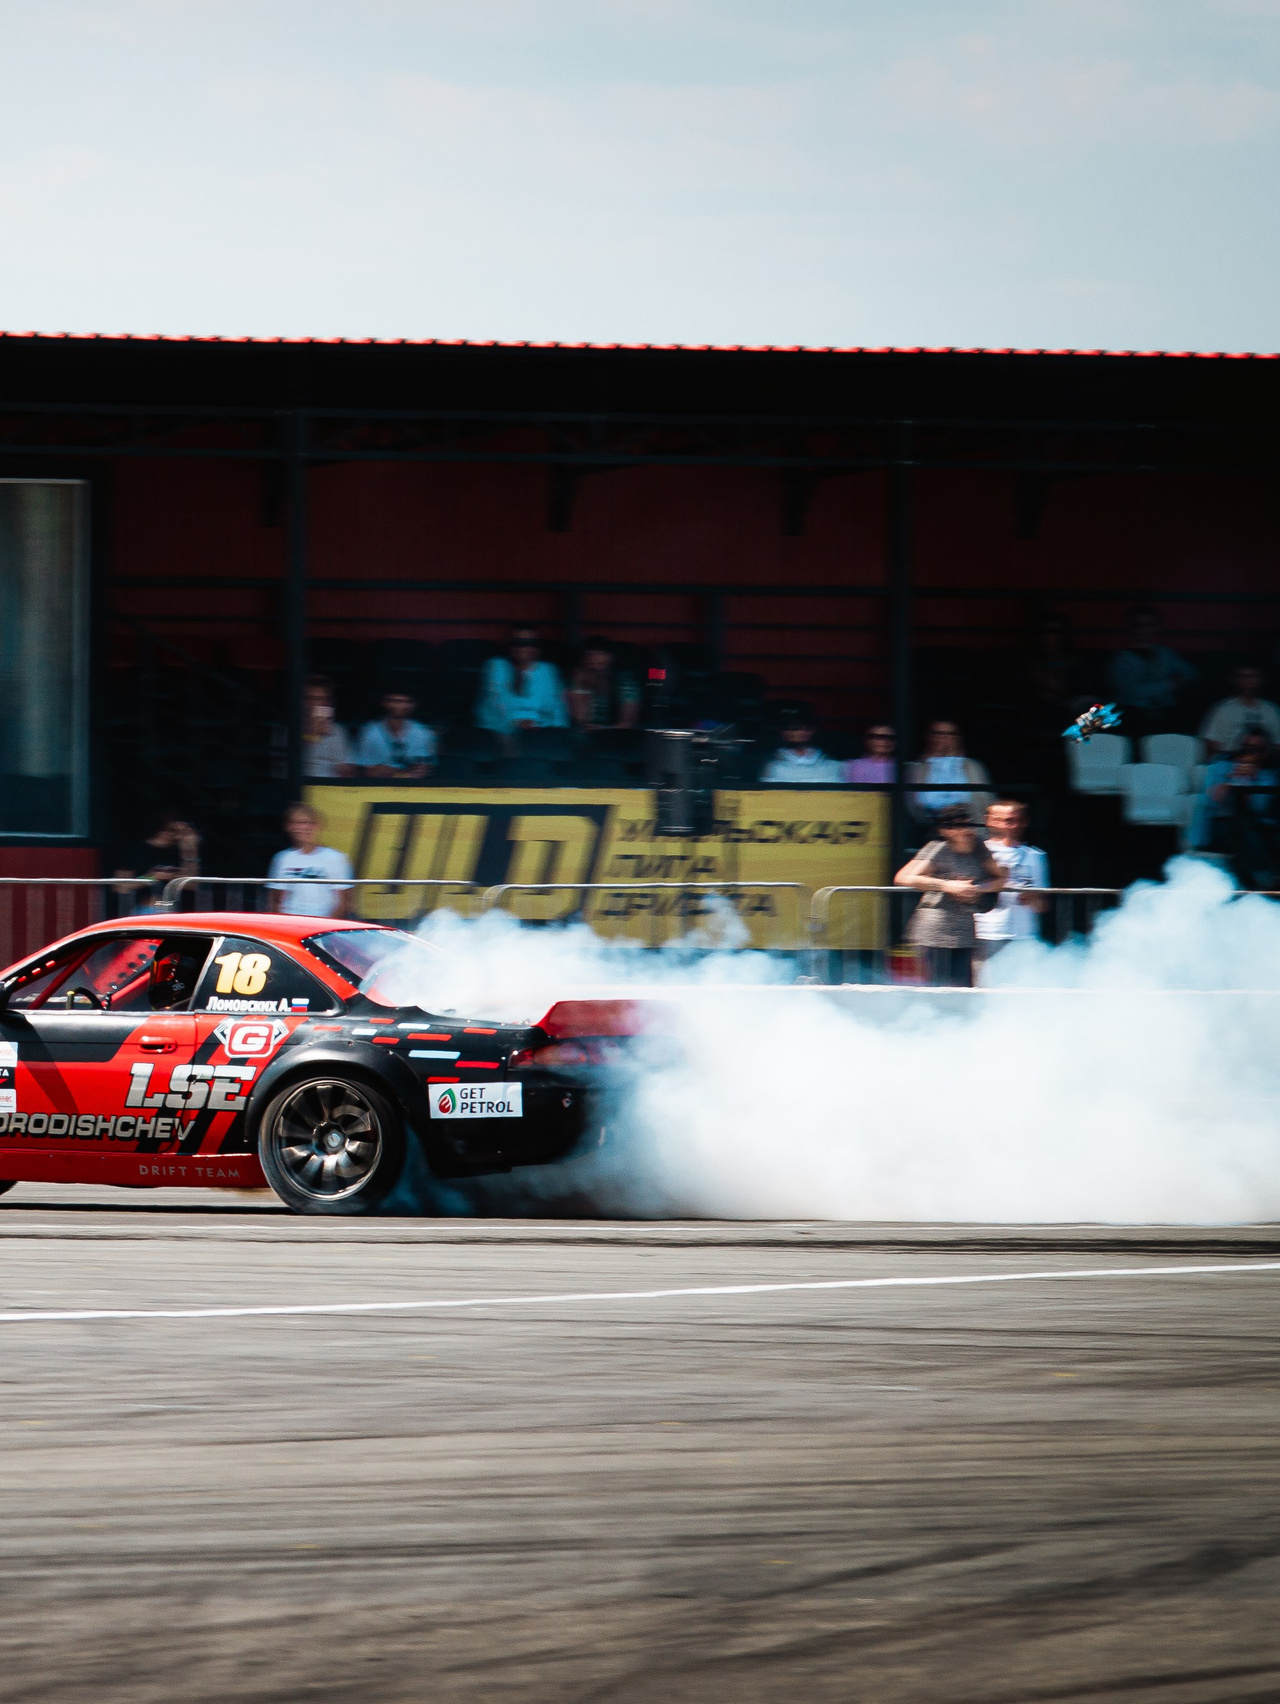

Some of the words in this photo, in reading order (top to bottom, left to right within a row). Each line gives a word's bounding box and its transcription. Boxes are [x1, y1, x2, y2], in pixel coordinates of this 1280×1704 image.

[214, 952, 272, 995] 18
[231, 1026, 269, 1052] G
[126, 1062, 256, 1111] LSE
[459, 1087, 486, 1099] GET
[460, 1101, 514, 1114] PETROL
[139, 1164, 187, 1177] DRIFT
[195, 1166, 240, 1179] TEAM
